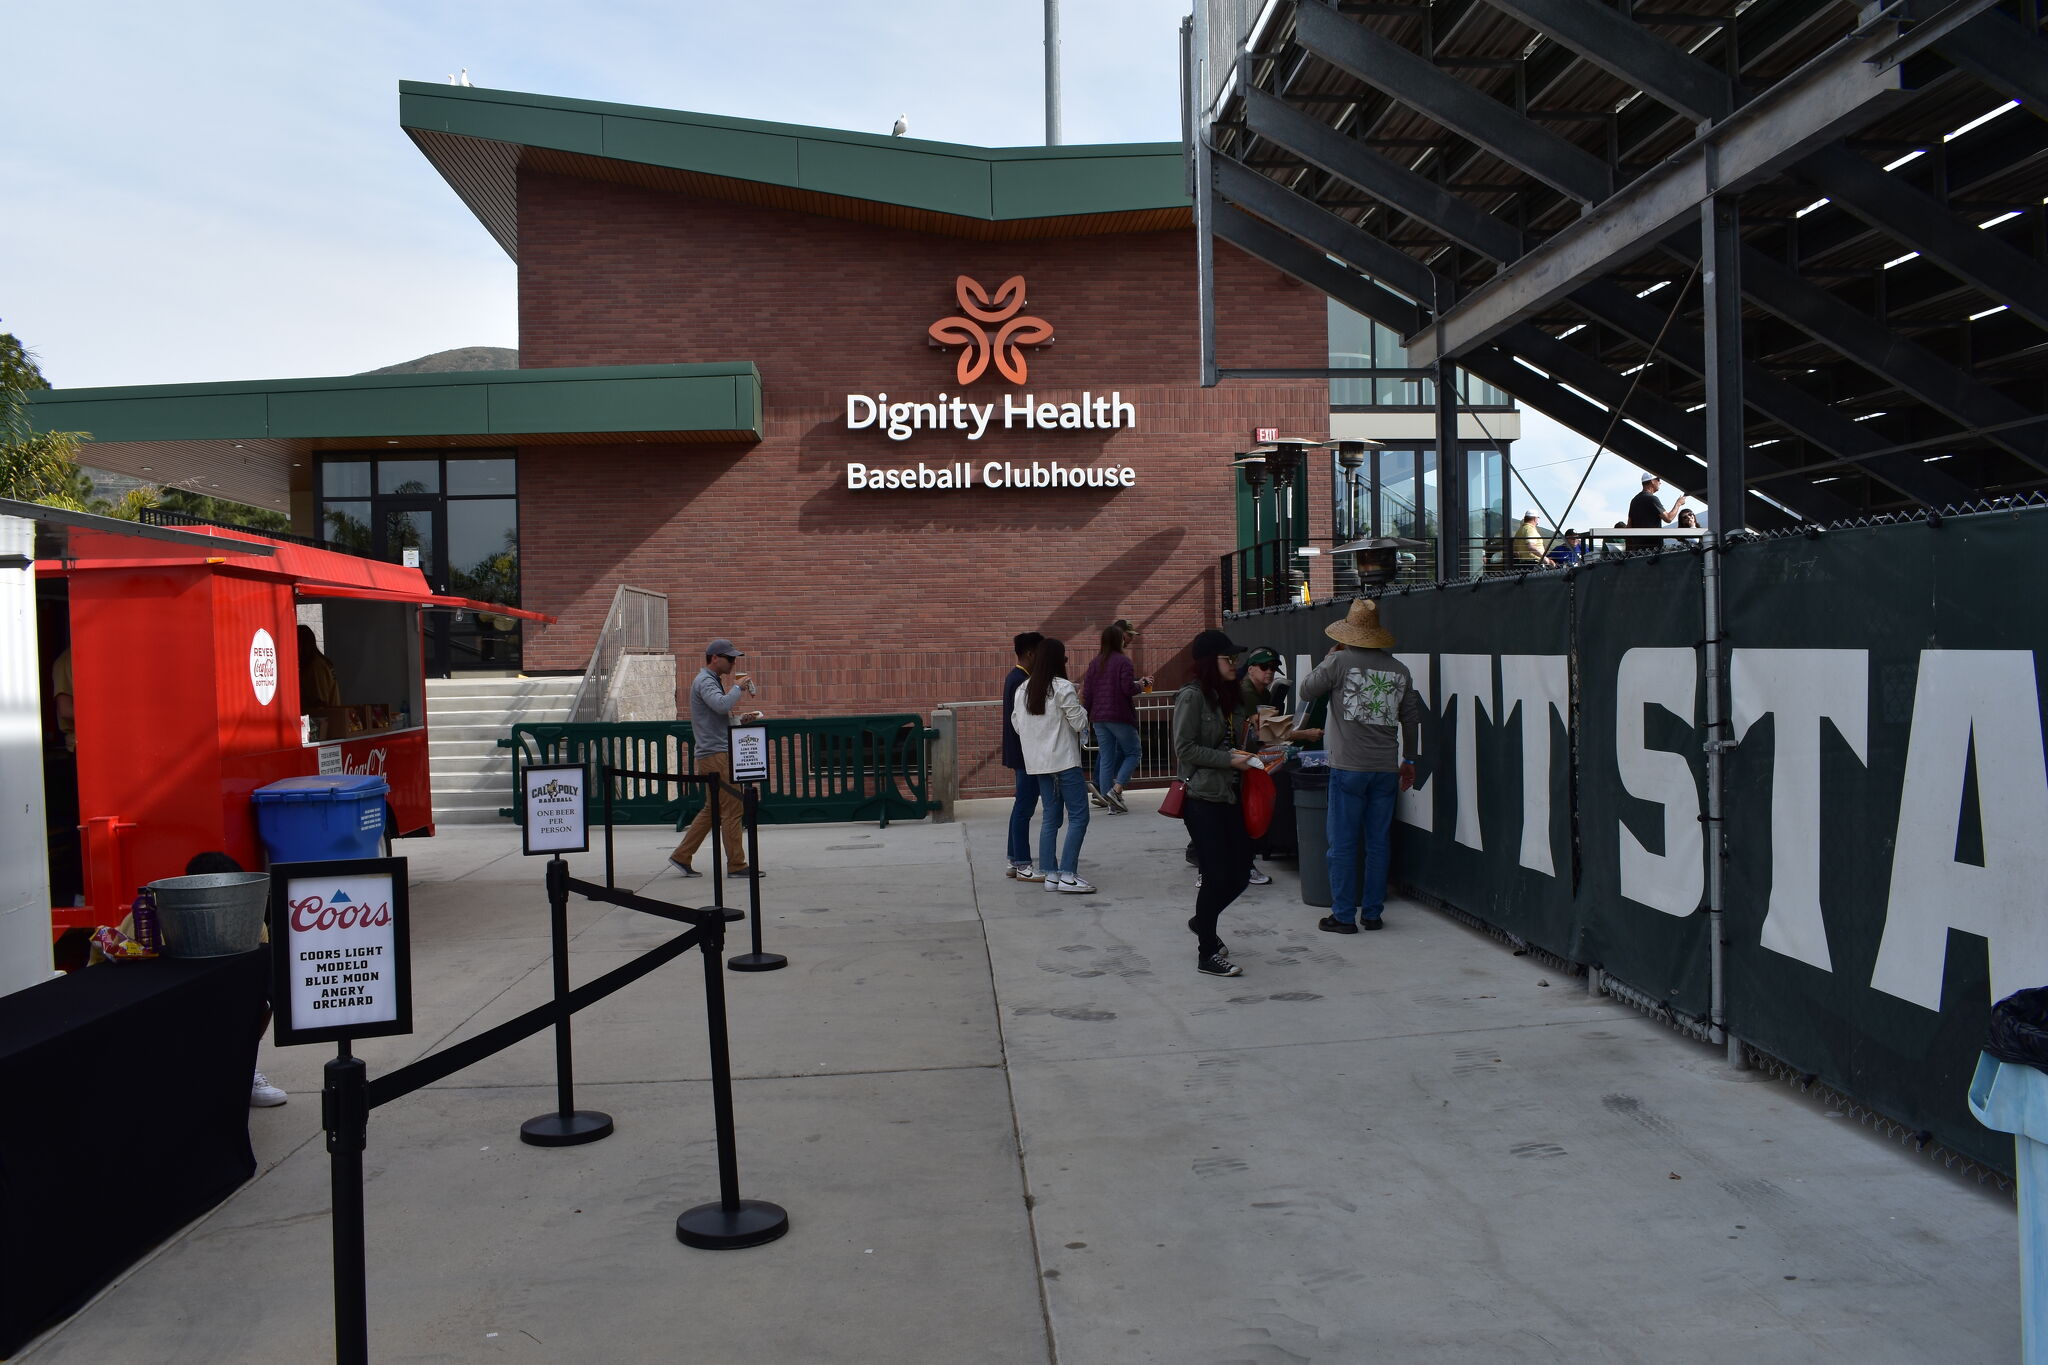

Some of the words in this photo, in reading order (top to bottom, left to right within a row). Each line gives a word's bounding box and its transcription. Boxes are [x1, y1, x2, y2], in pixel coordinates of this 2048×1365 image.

[847, 393, 994, 440] Dignity
[1004, 391, 1136, 429] Health
[1259, 428, 1277, 442] EXIT
[847, 462, 971, 489] Baseball
[983, 461, 1136, 488] Clubhouse
[254, 648, 273, 657] REYES
[531, 786, 547, 799] CAL
[558, 785, 578, 797] POLY
[537, 809, 555, 817] ONE
[555, 808, 575, 816] BEER
[541, 826, 572, 834] PERSON
[289, 895, 392, 932] Coors
[300, 949, 341, 961] COORS
[345, 946, 383, 958] LIGHT
[316, 960, 368, 973] MODELO
[305, 976, 339, 987] BLUE
[343, 971, 380, 983] MOON
[321, 985, 365, 998] ANGRY
[313, 996, 373, 1010] ORCHARD
